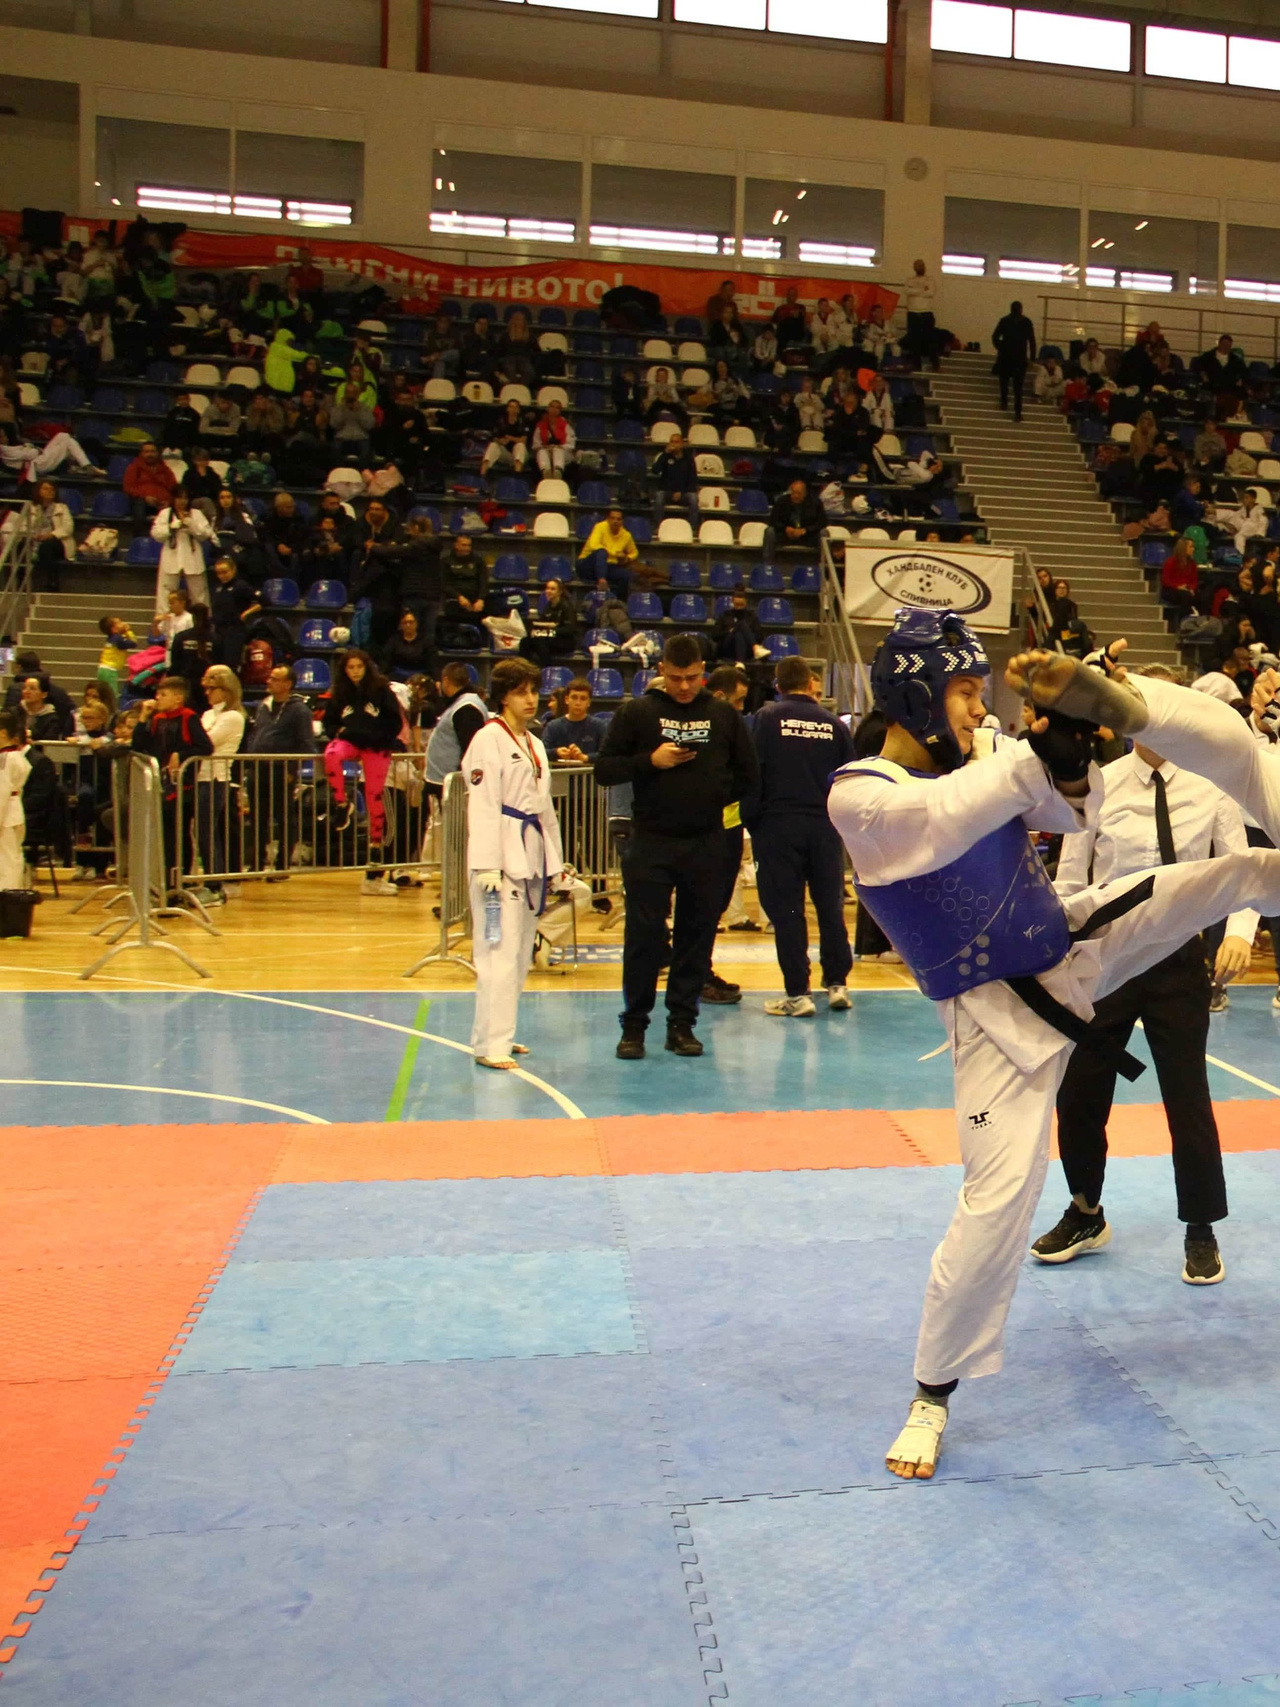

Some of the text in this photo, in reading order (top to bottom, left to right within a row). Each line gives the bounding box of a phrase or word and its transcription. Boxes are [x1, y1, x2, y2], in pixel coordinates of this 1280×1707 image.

[886, 562, 969, 590] ХАНДБАЛЕН КЛУБ
[900, 589, 953, 606] СЛИВНИЦА
[780, 719, 833, 733] HEREYA
[781, 728, 833, 741] BULGARIA
